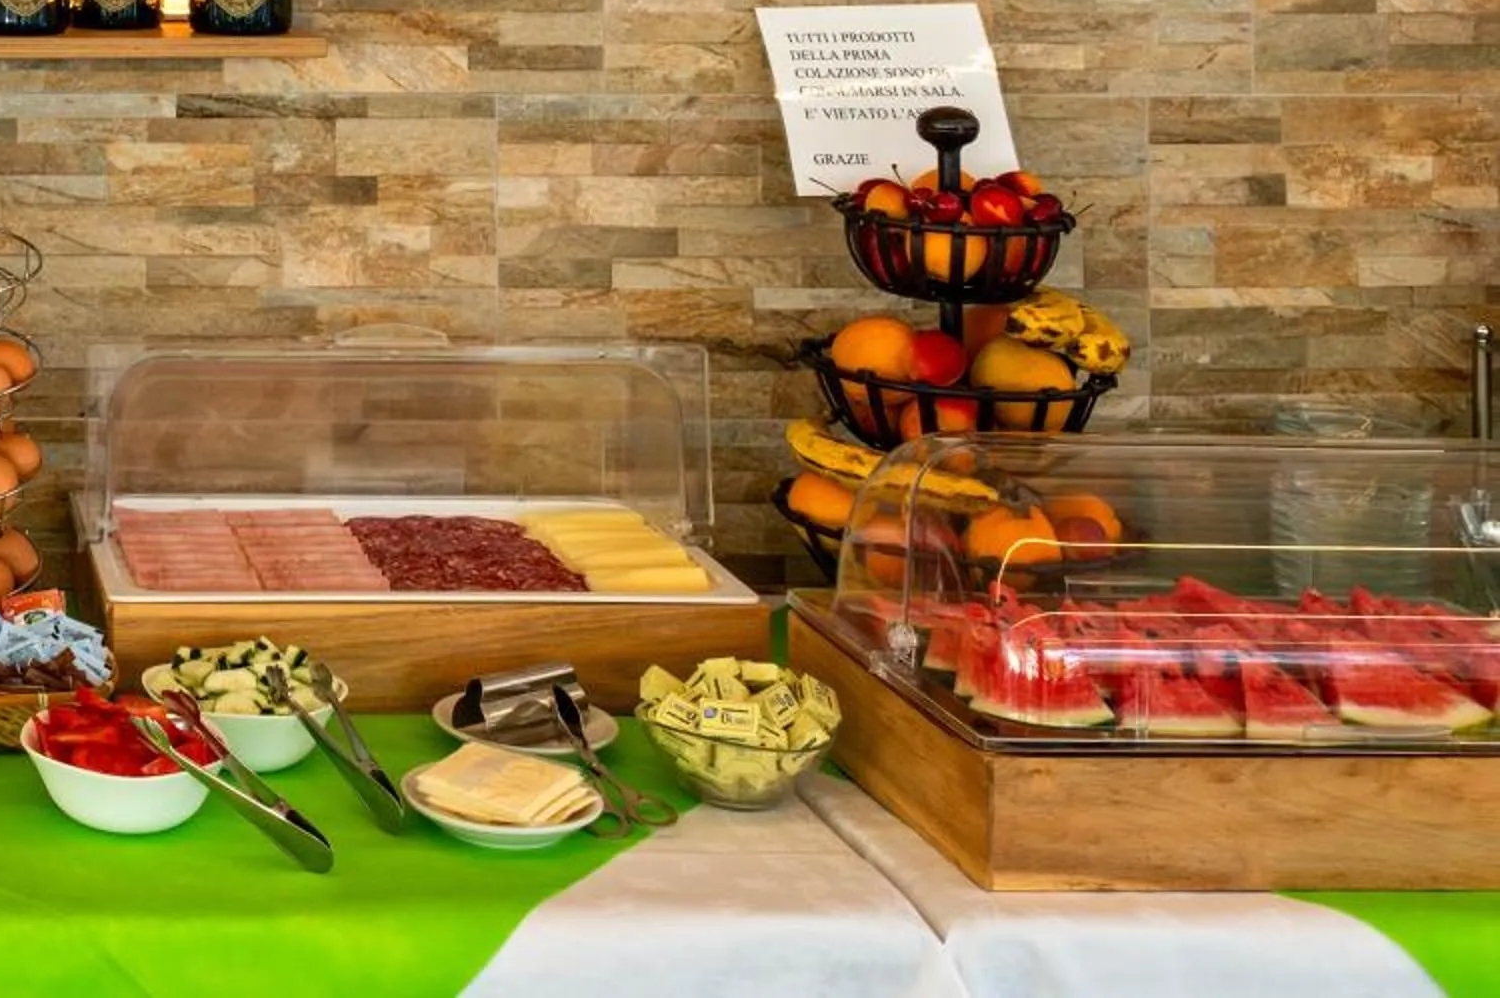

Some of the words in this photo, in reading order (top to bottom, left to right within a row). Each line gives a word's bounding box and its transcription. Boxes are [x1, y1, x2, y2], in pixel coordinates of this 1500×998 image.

[786, 32, 829, 43] TUTTI
[841, 31, 916, 43] PRODOTTI
[790, 49, 840, 61] DELLA
[842, 49, 892, 61] PRIMA
[794, 66, 881, 79] COLAZIONE
[883, 66, 925, 79] SONO
[901, 85, 918, 98] IN
[920, 85, 965, 98] SALA.
[821, 106, 890, 120] VIETATO
[812, 153, 871, 166] GRAZIE
